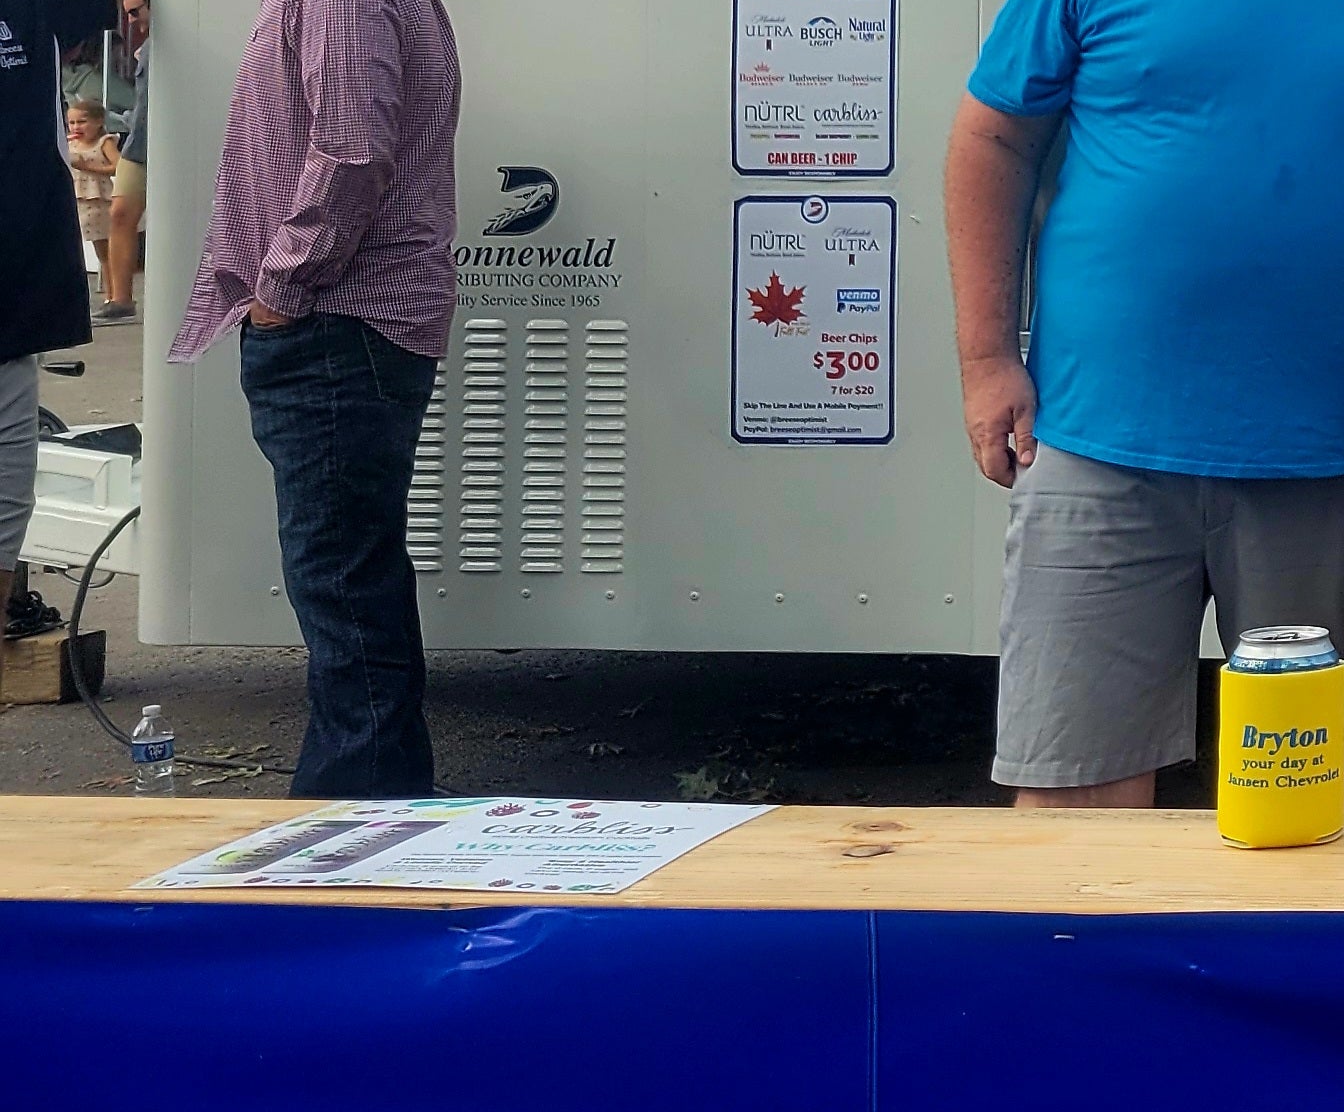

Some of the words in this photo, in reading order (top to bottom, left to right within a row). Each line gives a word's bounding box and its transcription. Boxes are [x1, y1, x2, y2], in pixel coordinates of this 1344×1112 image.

[746, 25, 793, 37] ULTRA
[849, 18, 885, 32] Natural
[801, 27, 842, 40] BUSCH
[739, 74, 784, 82] Budweiser
[789, 74, 834, 82] Budweiser
[838, 74, 882, 83] Budweiser
[814, 102, 882, 122] carbliss
[768, 153, 788, 164] CAN
[791, 153, 816, 164] BEER
[825, 153, 829, 164] 1
[832, 153, 857, 164] CHIP
[825, 239, 879, 251] ULTRA
[455, 238, 616, 267] onnewald
[456, 274, 534, 287] RIBUTING
[539, 274, 622, 287] COMPANY
[457, 294, 477, 309] lity
[481, 294, 527, 306] Service
[532, 294, 565, 306] Since
[571, 295, 600, 306] 1965
[839, 292, 878, 300] venmo
[849, 305, 880, 313] PayPal
[822, 334, 846, 343] Beer
[849, 334, 877, 345] Chips
[831, 386, 837, 395] 7
[839, 386, 853, 395] for
[855, 386, 874, 395] $20
[1242, 725, 1328, 755] Bryton
[1242, 758, 1275, 771] your
[1280, 757, 1308, 771] day
[1312, 755, 1324, 766] at
[1228, 773, 1269, 788] Jansen
[1276, 768, 1339, 788] Chevrolet
[482, 820, 694, 836] carbliss
[455, 842, 513, 852] Why
